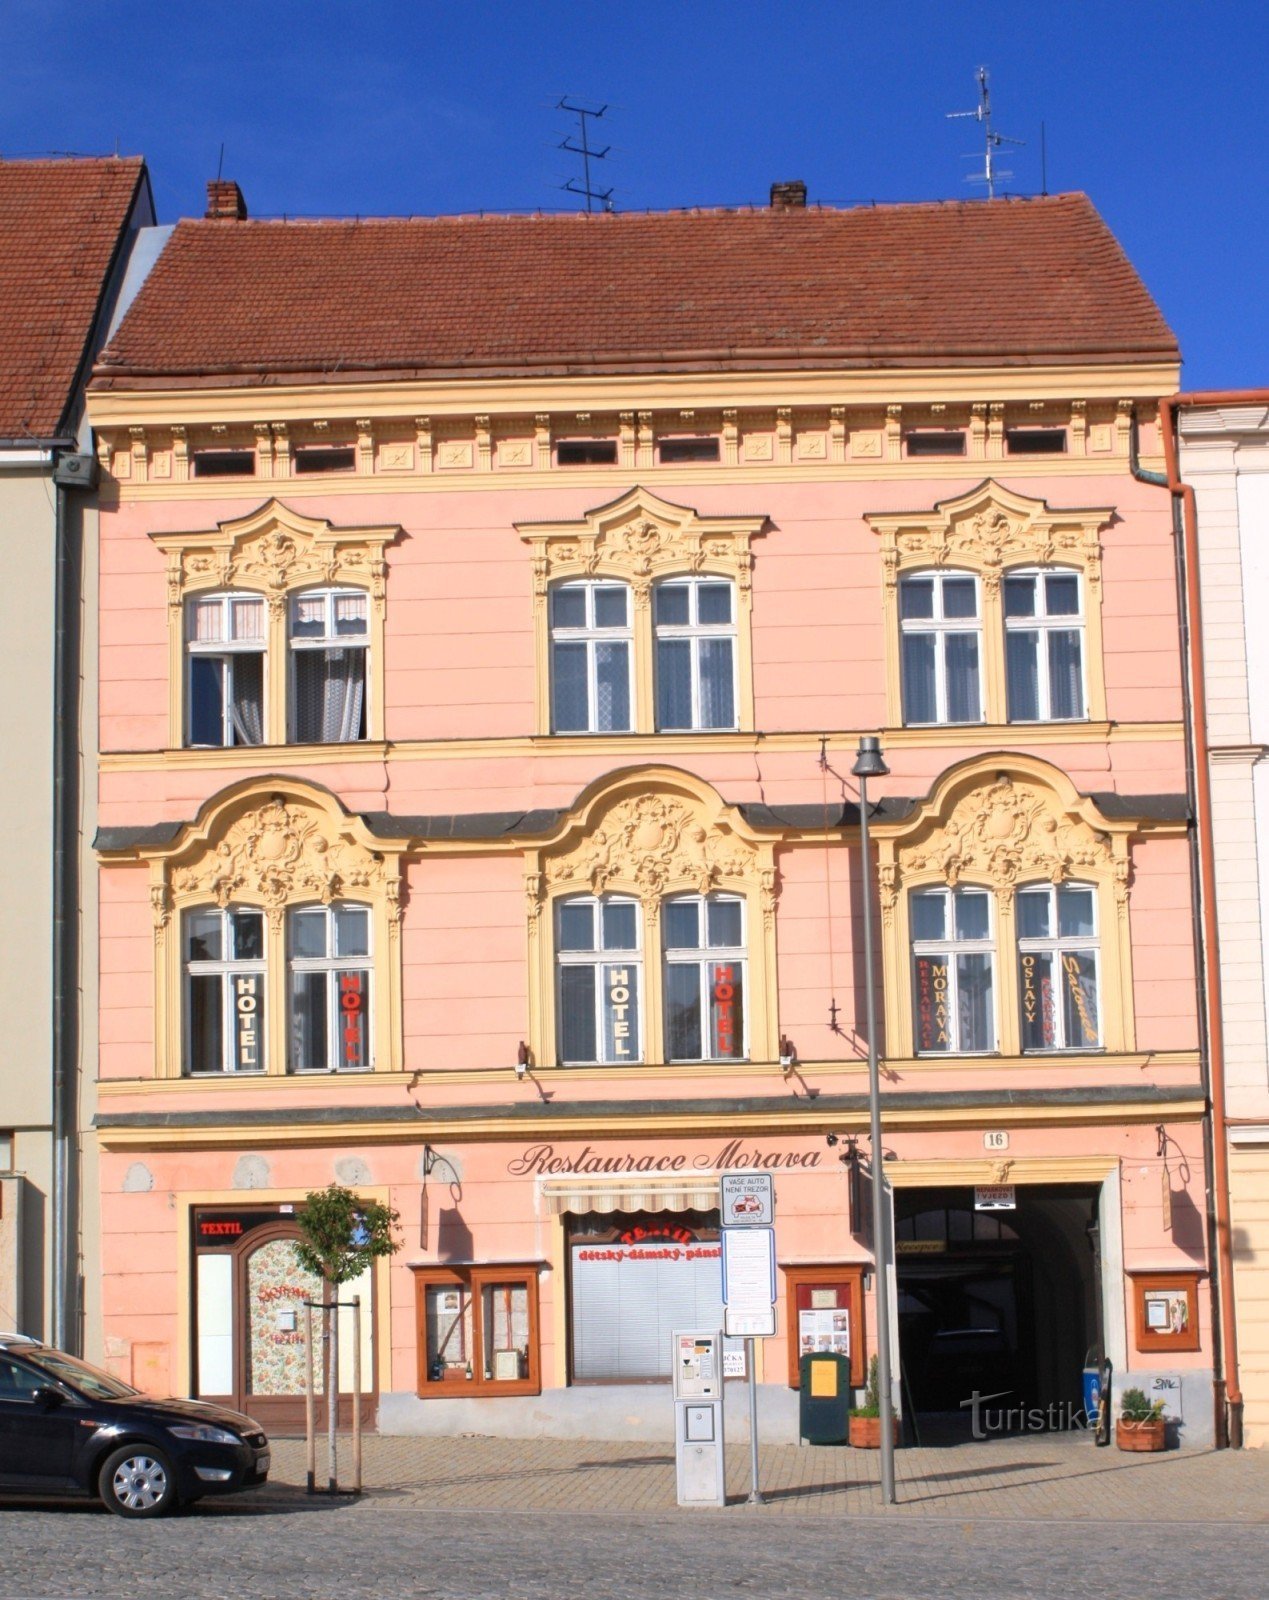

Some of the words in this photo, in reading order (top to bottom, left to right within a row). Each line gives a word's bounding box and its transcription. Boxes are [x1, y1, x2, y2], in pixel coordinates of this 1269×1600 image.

[237, 978, 256, 1064] HOTEL
[341, 975, 361, 1062] HOTEL
[610, 969, 630, 1055] HOTEL
[715, 965, 734, 1053] HOTEL
[932, 965, 948, 1042] MORAVA
[1022, 956, 1036, 1023] OSLAVY
[507, 1144, 687, 1176] Restaurace
[692, 1138, 823, 1170] Morava
[989, 1133, 1003, 1146] 16
[200, 1222, 243, 1235] TEXTIL
